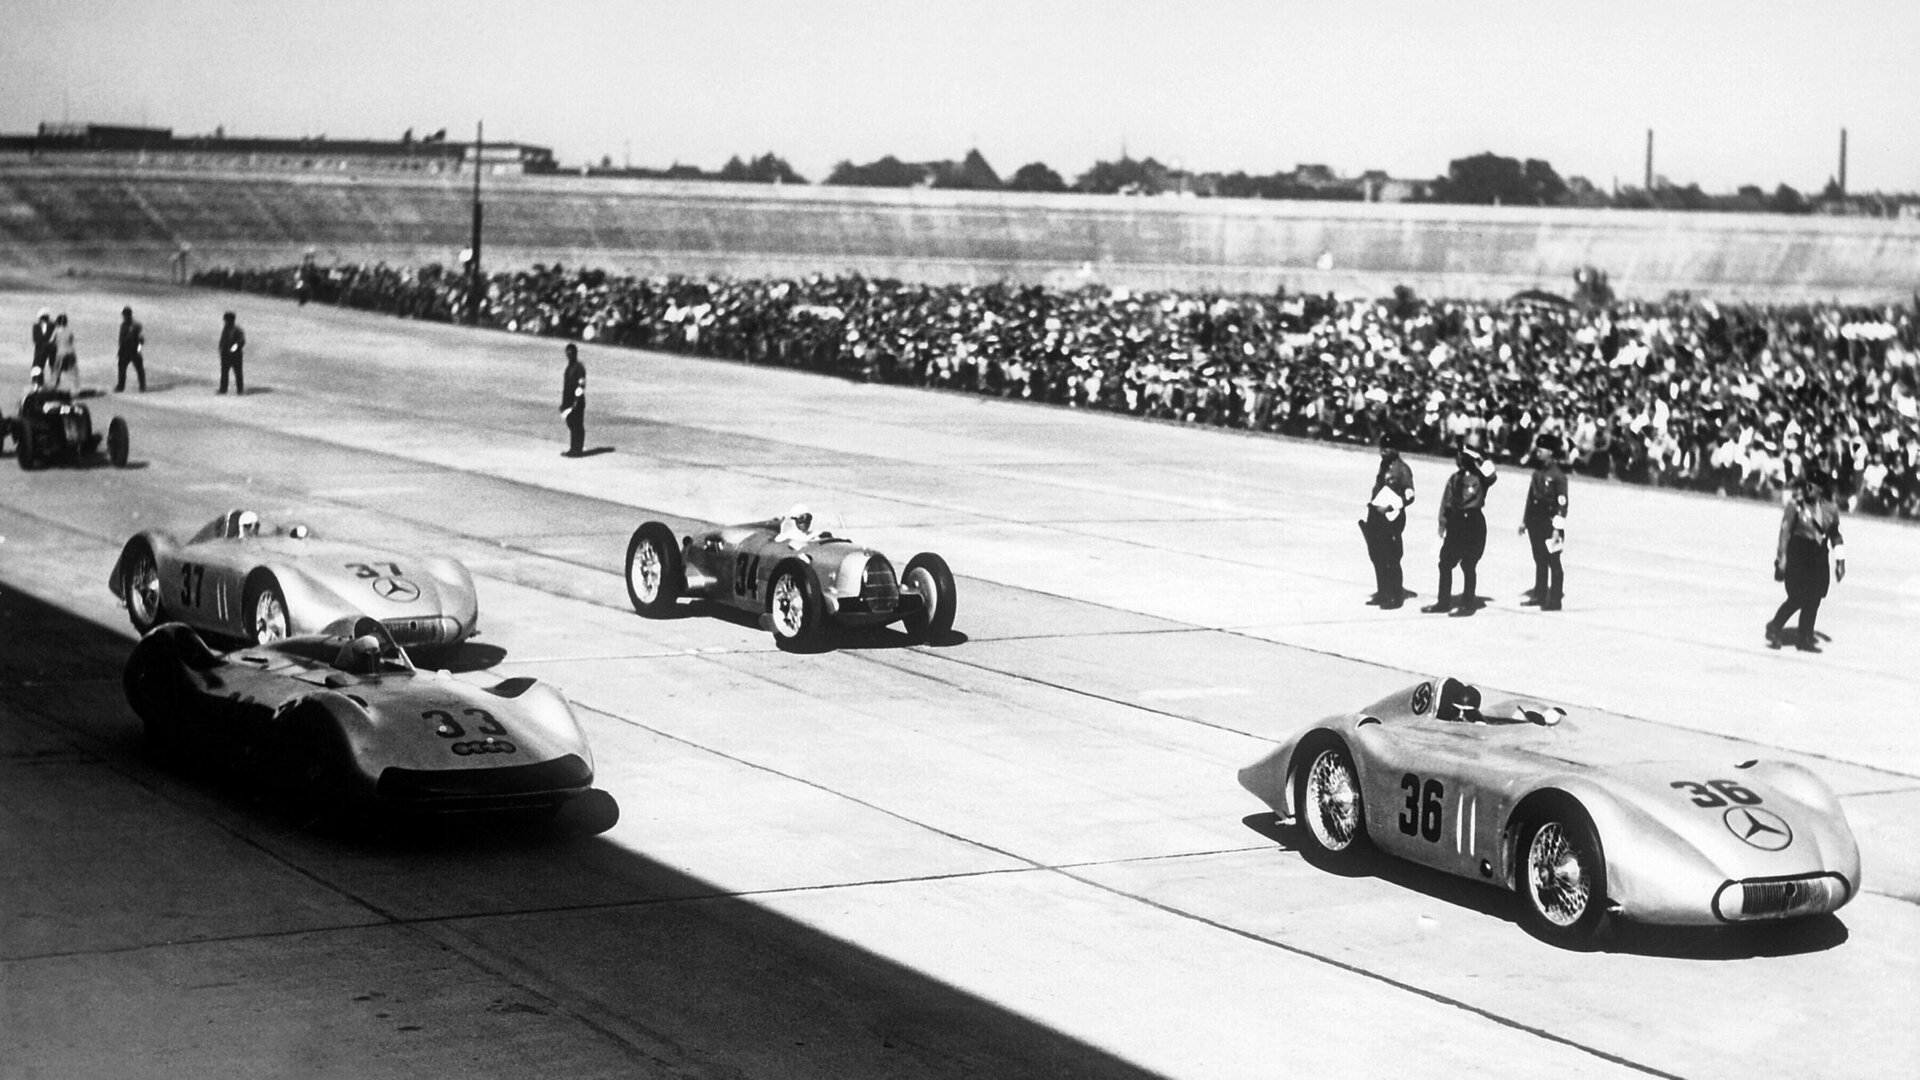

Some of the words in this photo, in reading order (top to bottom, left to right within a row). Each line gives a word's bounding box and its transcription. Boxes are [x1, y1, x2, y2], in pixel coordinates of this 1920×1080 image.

[180, 562, 205, 608] 37
[344, 562, 402, 579] 37
[735, 552, 760, 599] 34
[421, 708, 508, 738] 33
[1399, 772, 1444, 843] 36
[1669, 779, 1763, 808] 36
